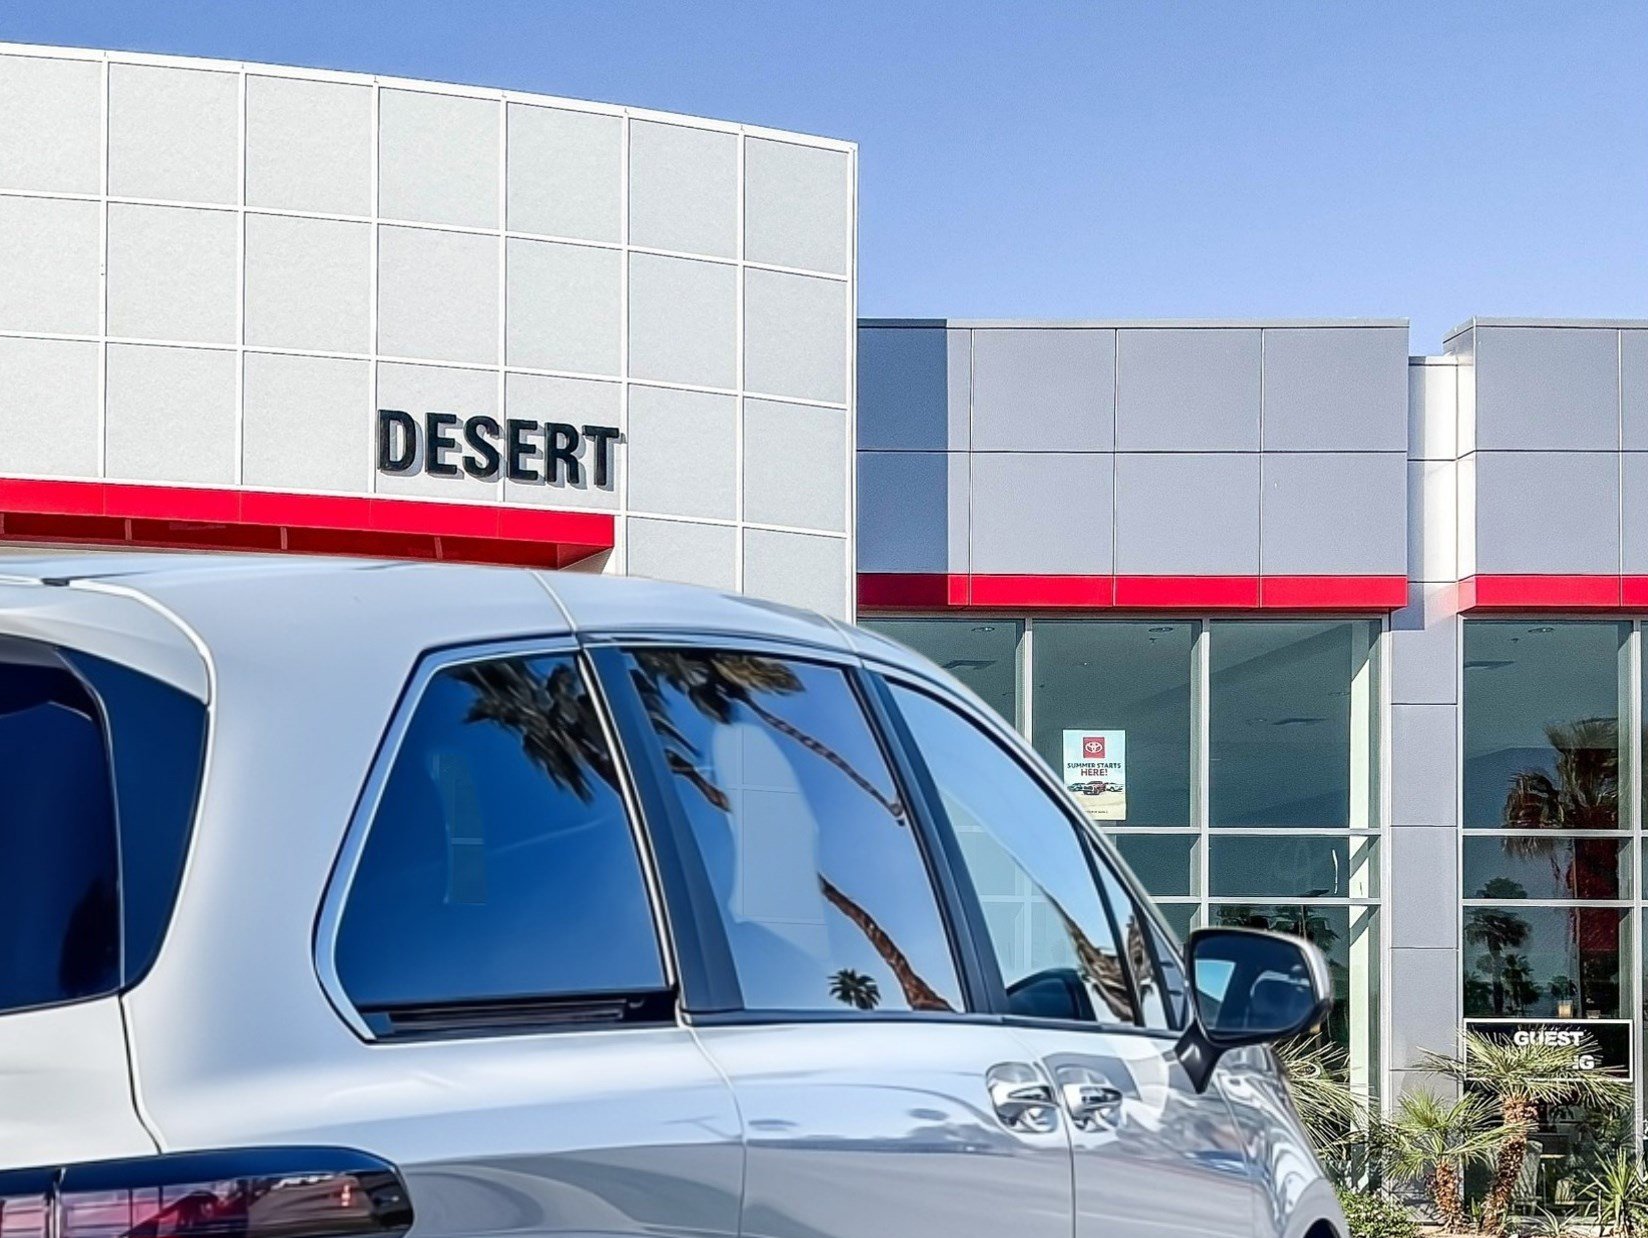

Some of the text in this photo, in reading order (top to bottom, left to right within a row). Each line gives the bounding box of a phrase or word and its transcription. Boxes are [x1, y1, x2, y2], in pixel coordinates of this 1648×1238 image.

[377, 409, 620, 486] DESERT
[1081, 768, 1108, 777] HERE!
[1513, 1030, 1584, 1047] GUEST
